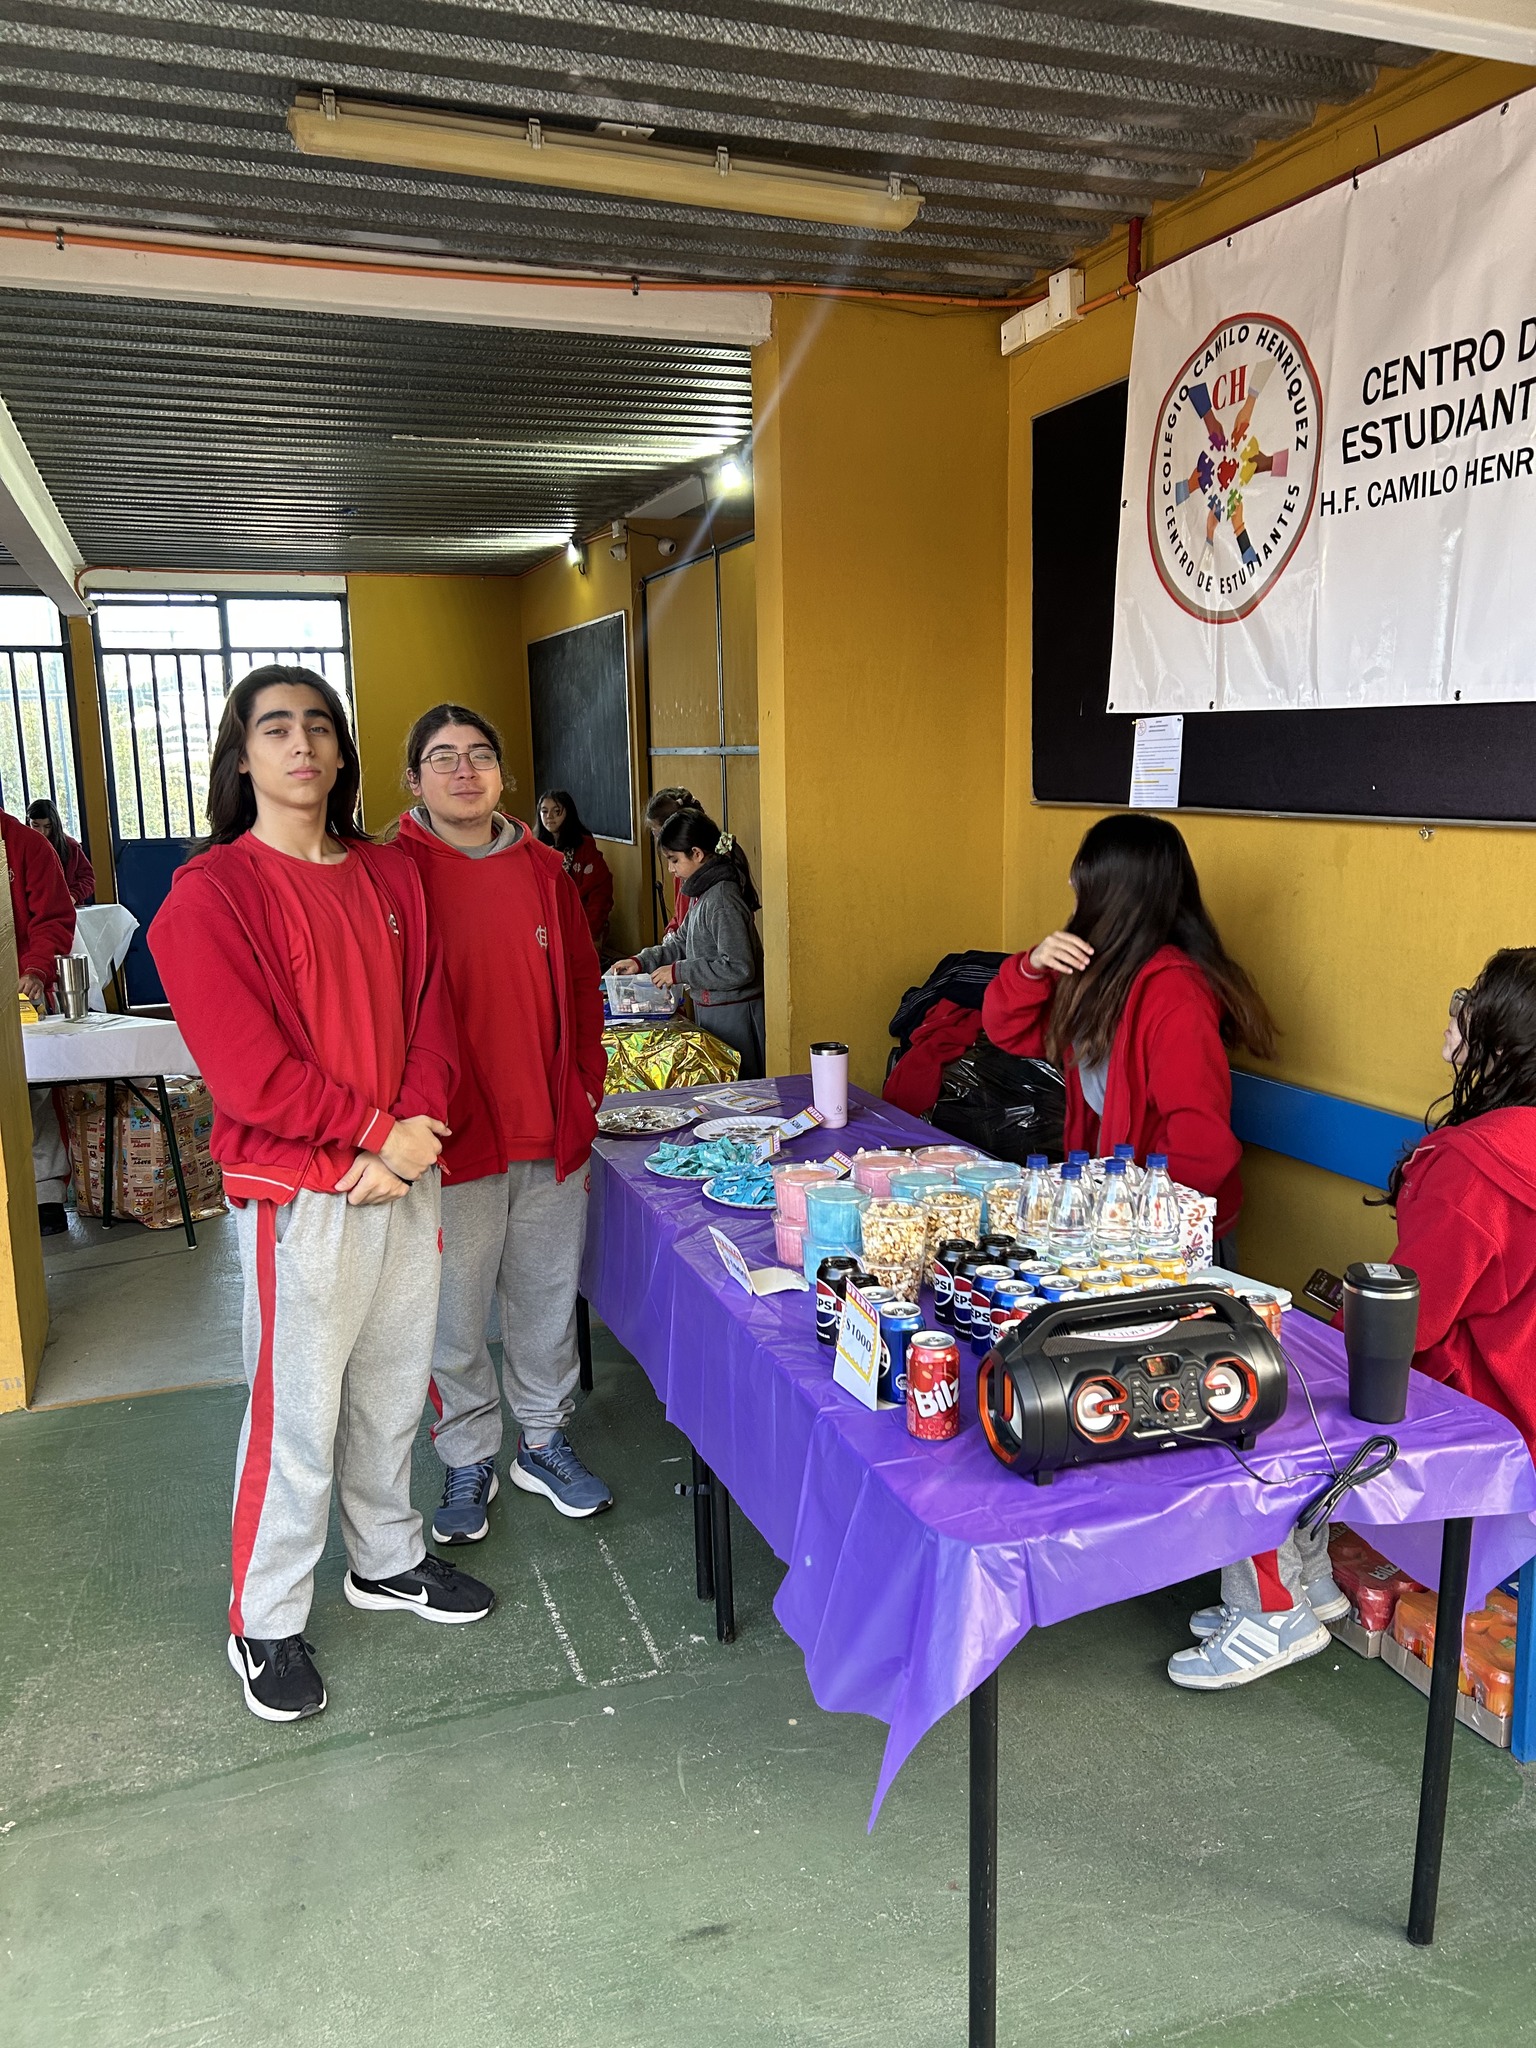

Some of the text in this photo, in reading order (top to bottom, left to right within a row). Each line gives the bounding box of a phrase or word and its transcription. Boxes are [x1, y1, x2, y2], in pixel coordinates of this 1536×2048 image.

[1212, 365, 1248, 411] CH
[1363, 329, 1505, 405] CENTRO
[1163, 325, 1308, 495] COLEGIO CAMILO HENRÍQUEZ
[1342, 376, 1536, 464] ESTUDIANT
[1320, 447, 1534, 516] H.F. CAMILO HENR
[1165, 484, 1300, 594] CENTRO DE ESTUDIANTES
[817, 1297, 836, 1311] PSI
[846, 1281, 877, 1323] OFERTA
[846, 1318, 872, 1352] $1000
[914, 1378, 959, 1418] Bilz
[1368, 1564, 1401, 1580] Bilz
